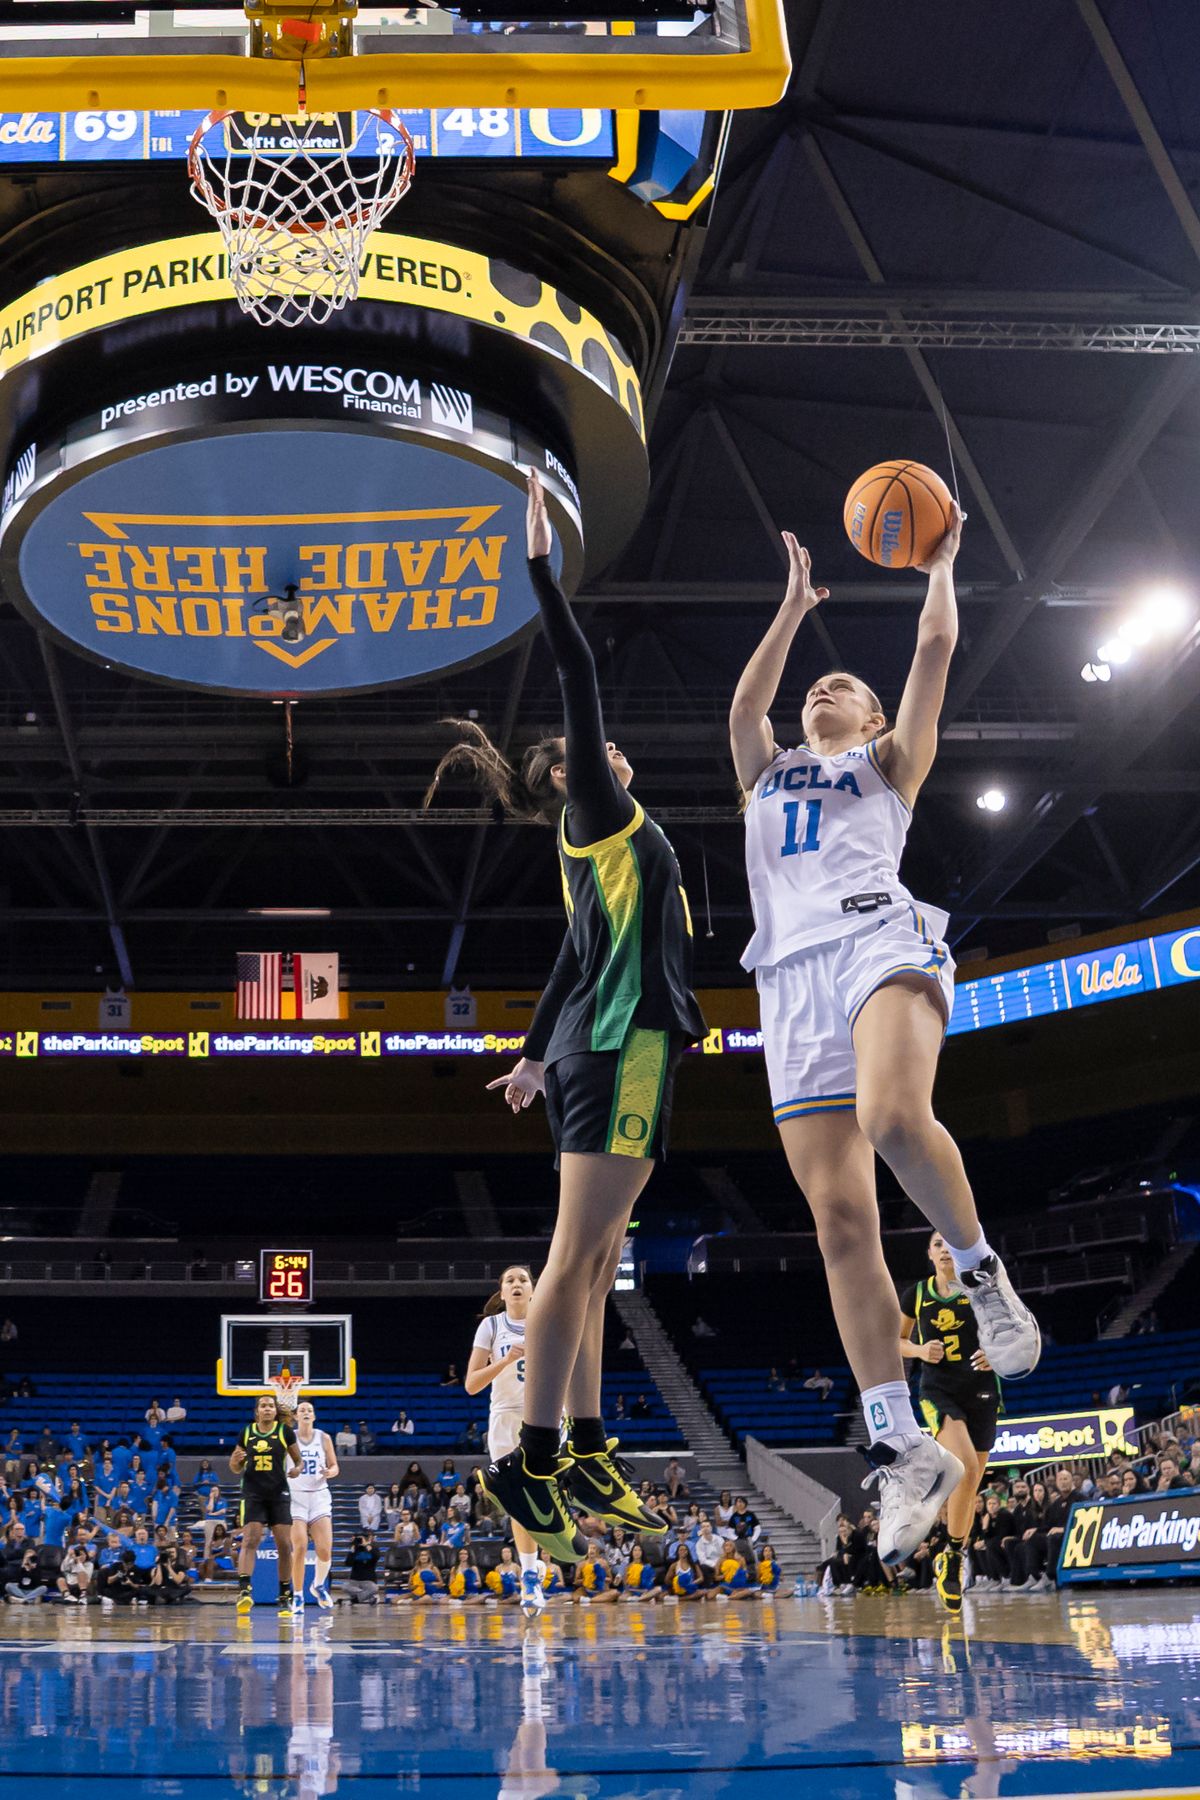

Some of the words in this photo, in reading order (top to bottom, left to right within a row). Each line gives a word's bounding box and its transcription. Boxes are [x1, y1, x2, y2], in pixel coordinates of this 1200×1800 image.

[0, 112, 57, 144] cla
[74, 111, 138, 142] 69
[442, 108, 510, 138] 48
[278, 136, 339, 149] Quarter
[0, 277, 113, 353] AIRPORT
[123, 251, 281, 298] PARKING
[101, 375, 217, 430] presented
[226, 373, 259, 398] by
[267, 365, 421, 405] WESCOM
[343, 394, 422, 420] Financial
[78, 542, 270, 594] HERE
[299, 535, 508, 590] MADE
[88, 586, 500, 637] CHAMPIONS
[761, 764, 863, 799] UCLA
[781, 798, 823, 858] 11
[1076, 952, 1143, 996] Ucla
[107, 1004, 123, 1017] 31
[452, 1003, 470, 1016] 32
[42, 1035, 185, 1054] theParkingSpot
[213, 1035, 357, 1054] theParkingSpot
[274, 1255, 308, 1270] 6:44
[270, 1271, 303, 1297] 26
[943, 1334, 962, 1362] 2
[300, 1450, 320, 1459] CLA
[1100, 1510, 1200, 1552] theParking
